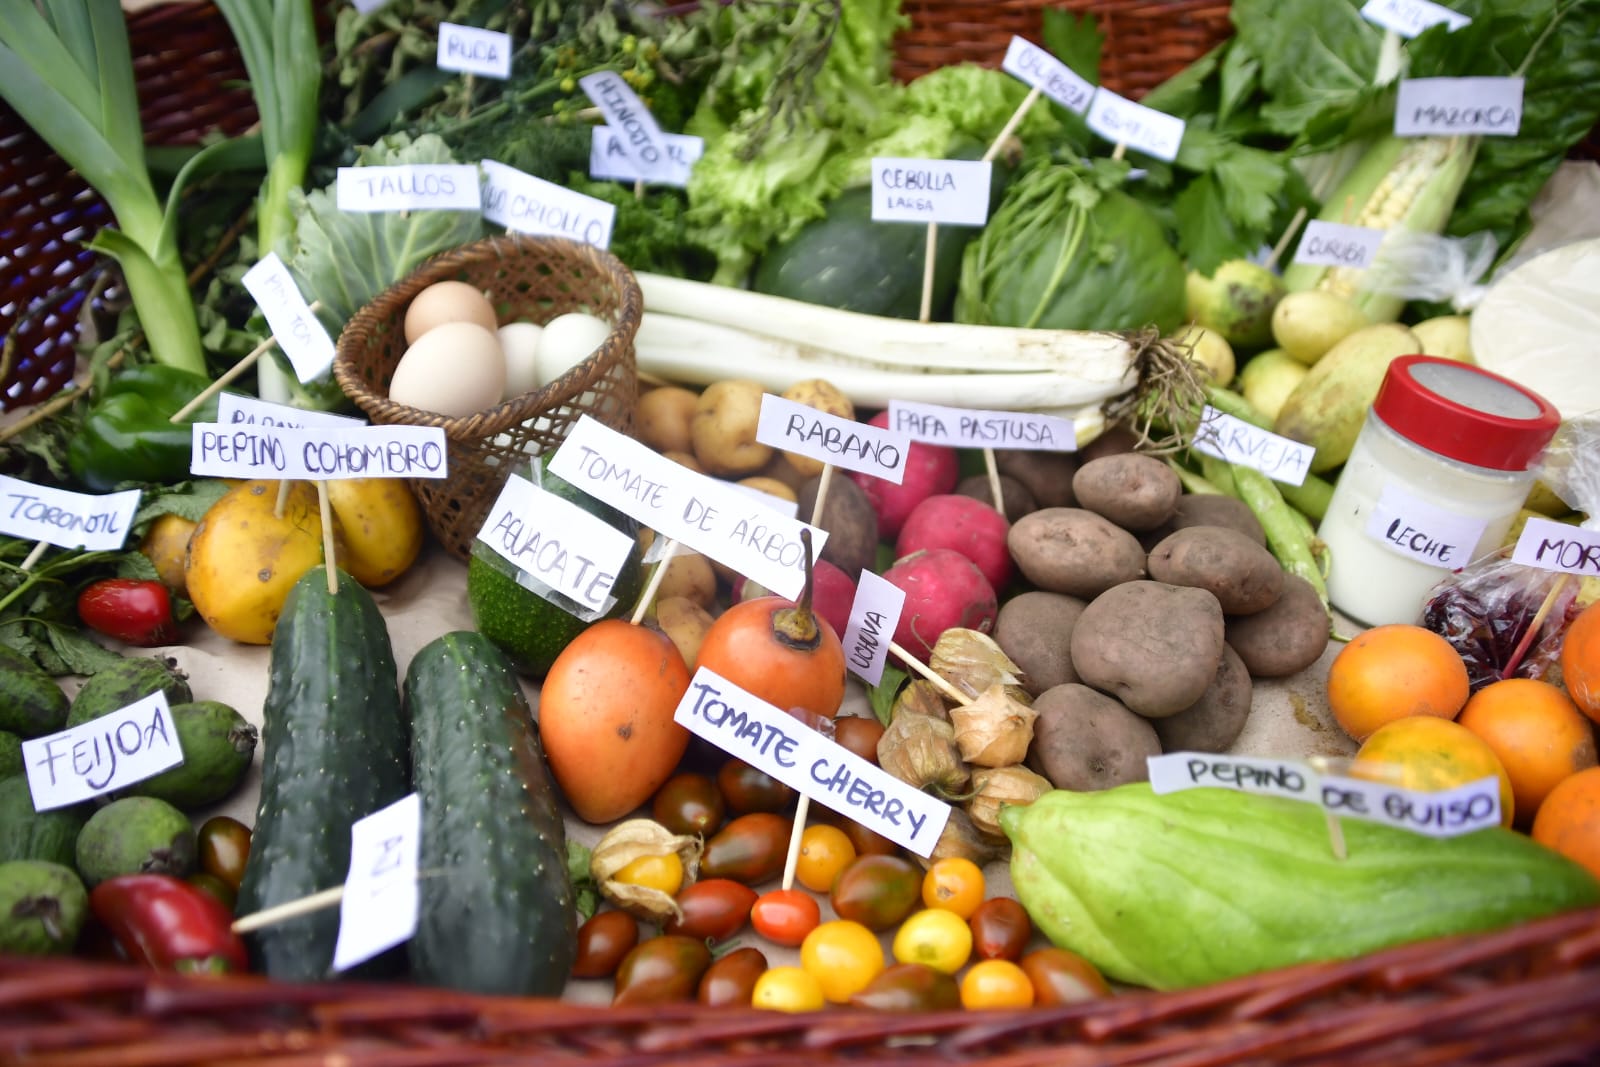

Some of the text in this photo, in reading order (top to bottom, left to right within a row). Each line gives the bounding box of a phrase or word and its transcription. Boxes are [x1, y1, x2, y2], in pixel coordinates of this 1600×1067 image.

[594, 78, 659, 163] HINOJO
[1413, 105, 1516, 128] MAZORCA
[357, 173, 457, 198] TALLOS
[882, 168, 956, 192] CEBOLLA
[510, 195, 601, 246] CRIOLLO
[202, 431, 442, 473] PEPINO COHOMBRO
[785, 414, 900, 469] RABANO
[896, 409, 1054, 444] PAPA PASTUSA
[7, 494, 120, 534] TORONJIL
[580, 445, 668, 509] TOMATE
[683, 496, 720, 532] DE
[490, 511, 615, 602] AGUACATE
[1386, 518, 1456, 562] LECHE
[850, 611, 887, 669] UCHUVA
[36, 706, 170, 789] FEIJOA
[692, 682, 927, 840] TOMATE CHERRY
[1188, 759, 1494, 827] PEPINO DE GUISO
